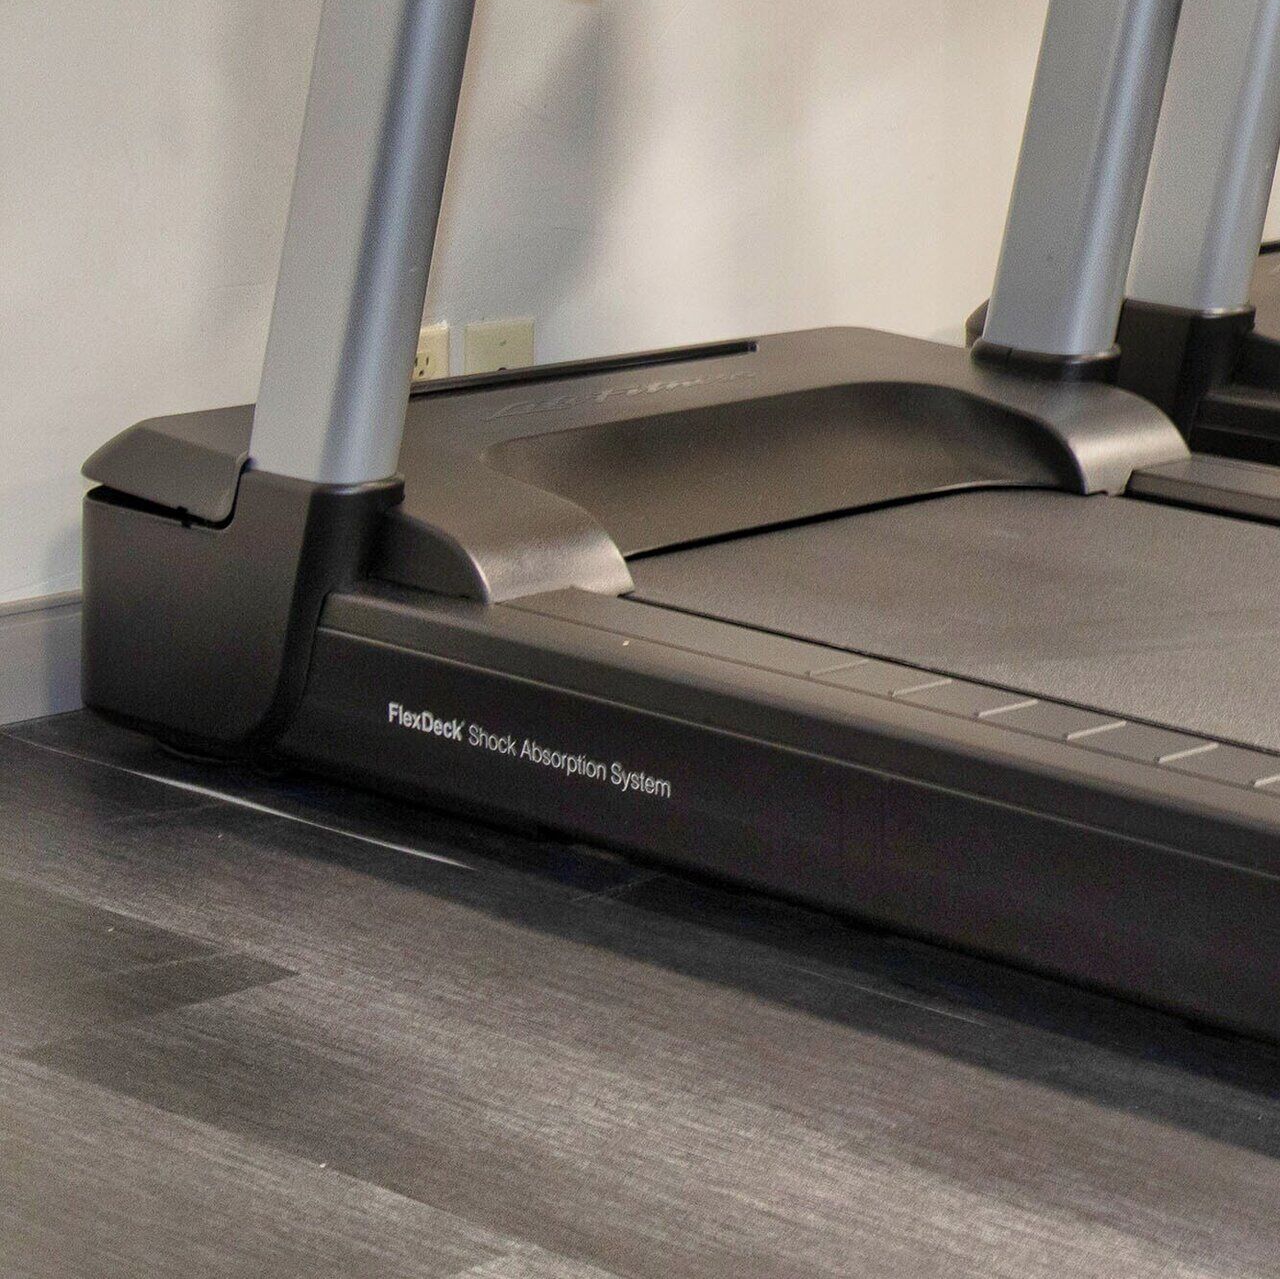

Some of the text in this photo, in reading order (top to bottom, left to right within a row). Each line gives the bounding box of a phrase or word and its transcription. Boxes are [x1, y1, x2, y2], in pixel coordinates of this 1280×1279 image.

[388, 701, 671, 798] FlexDeck Shock Absorption System
